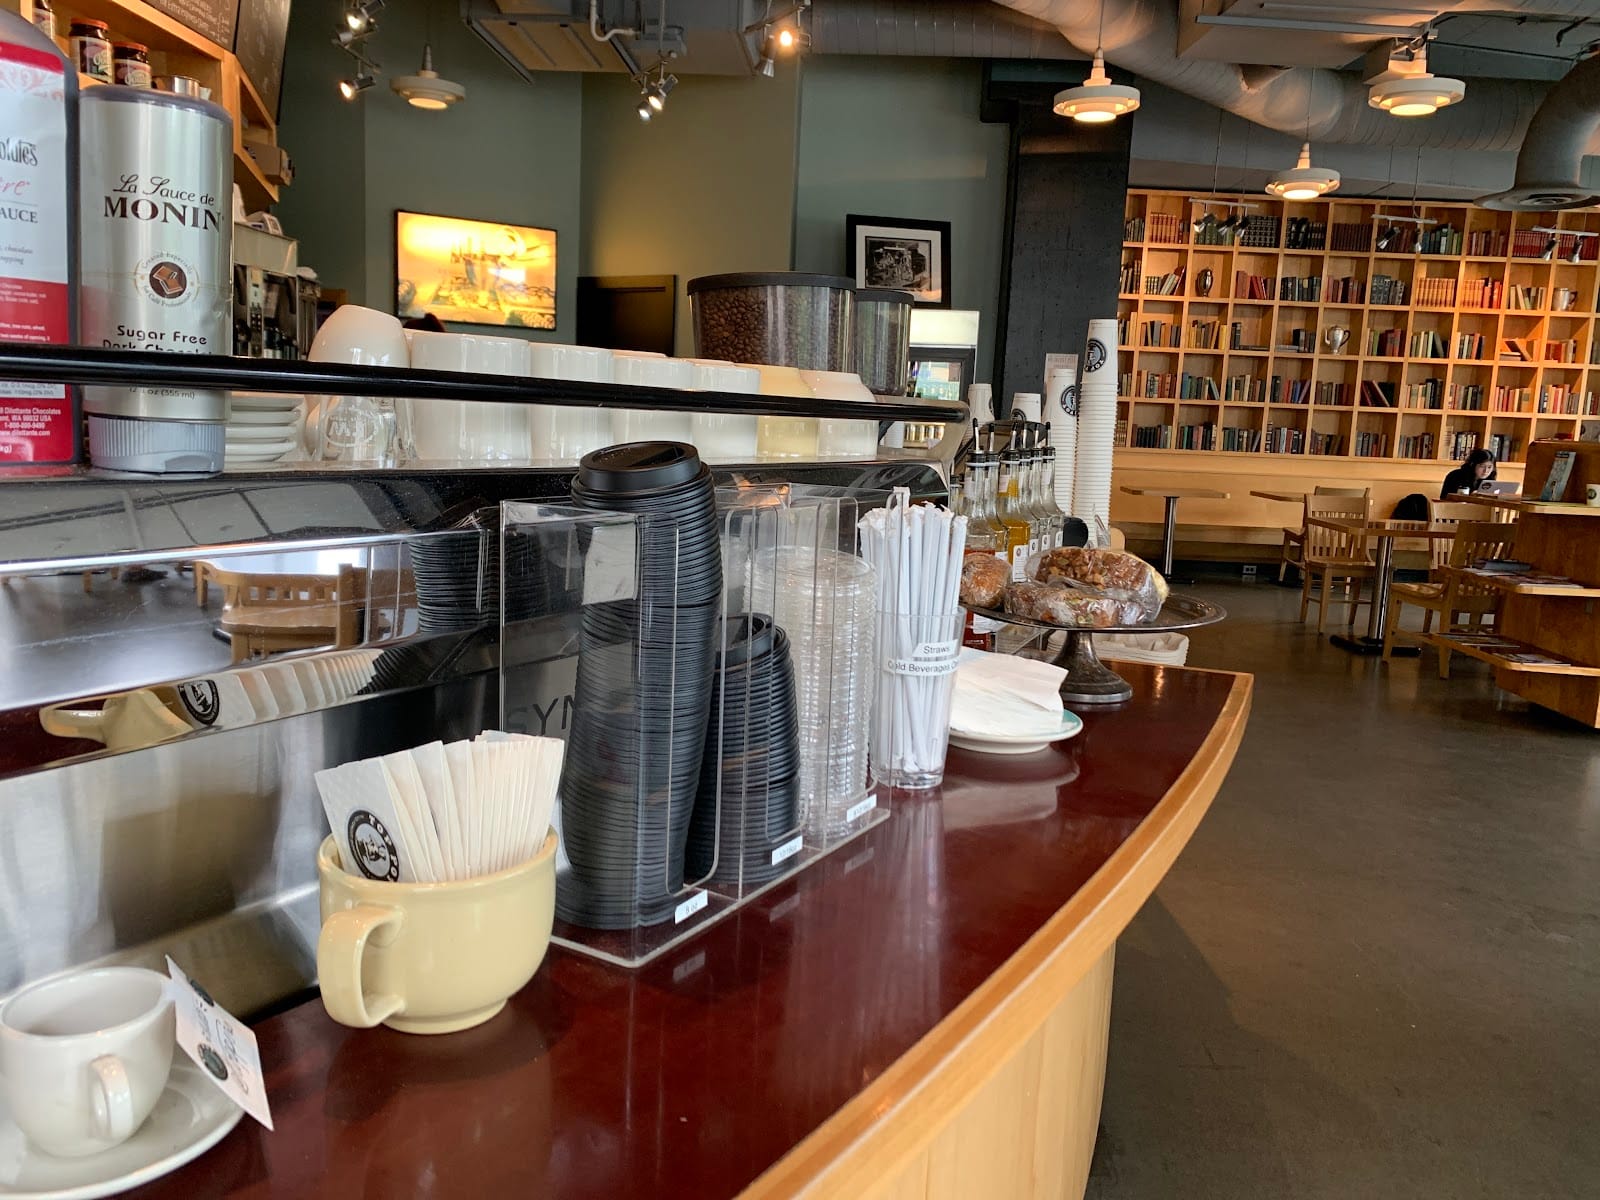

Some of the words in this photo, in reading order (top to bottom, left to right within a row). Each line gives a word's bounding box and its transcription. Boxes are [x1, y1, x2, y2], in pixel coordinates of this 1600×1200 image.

[113, 174, 139, 193] La
[143, 176, 196, 202] Sauce
[200, 194, 215, 206] de
[104, 196, 221, 232] MONIN
[117, 325, 165, 341] Sugar
[173, 331, 208, 345] Free
[923, 645, 951, 655] Straws
